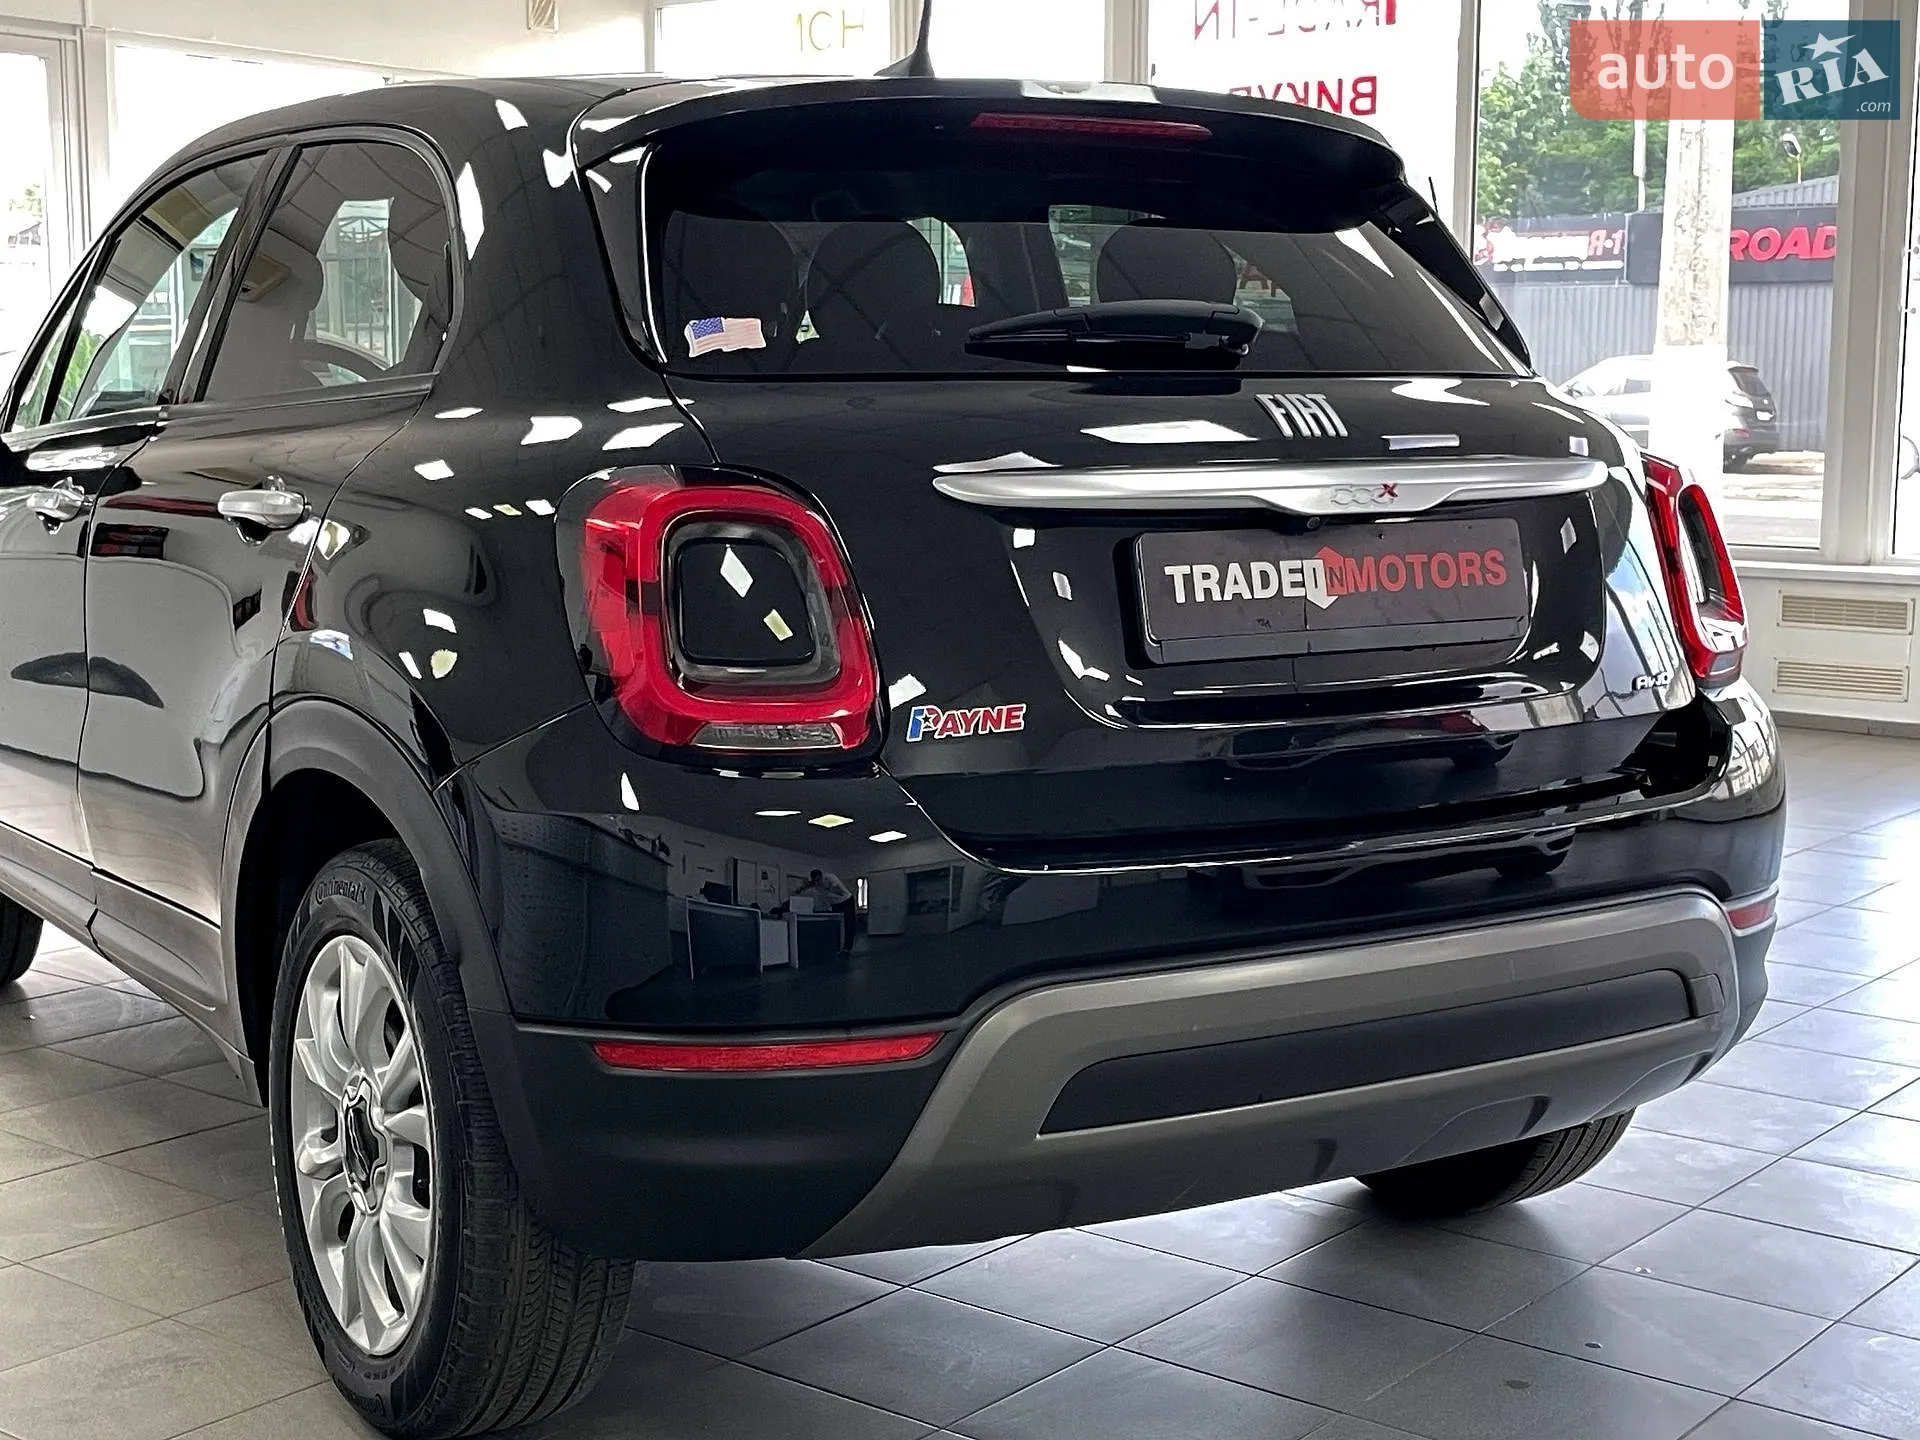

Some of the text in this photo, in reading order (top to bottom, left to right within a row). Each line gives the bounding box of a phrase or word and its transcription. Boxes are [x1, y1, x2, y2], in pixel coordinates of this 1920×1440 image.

[1254, 393, 1348, 438] FIAT
[1164, 560, 1305, 603] TRADE
[1346, 549, 1507, 593] MOTORS
[906, 704, 1027, 742] PAYNE
